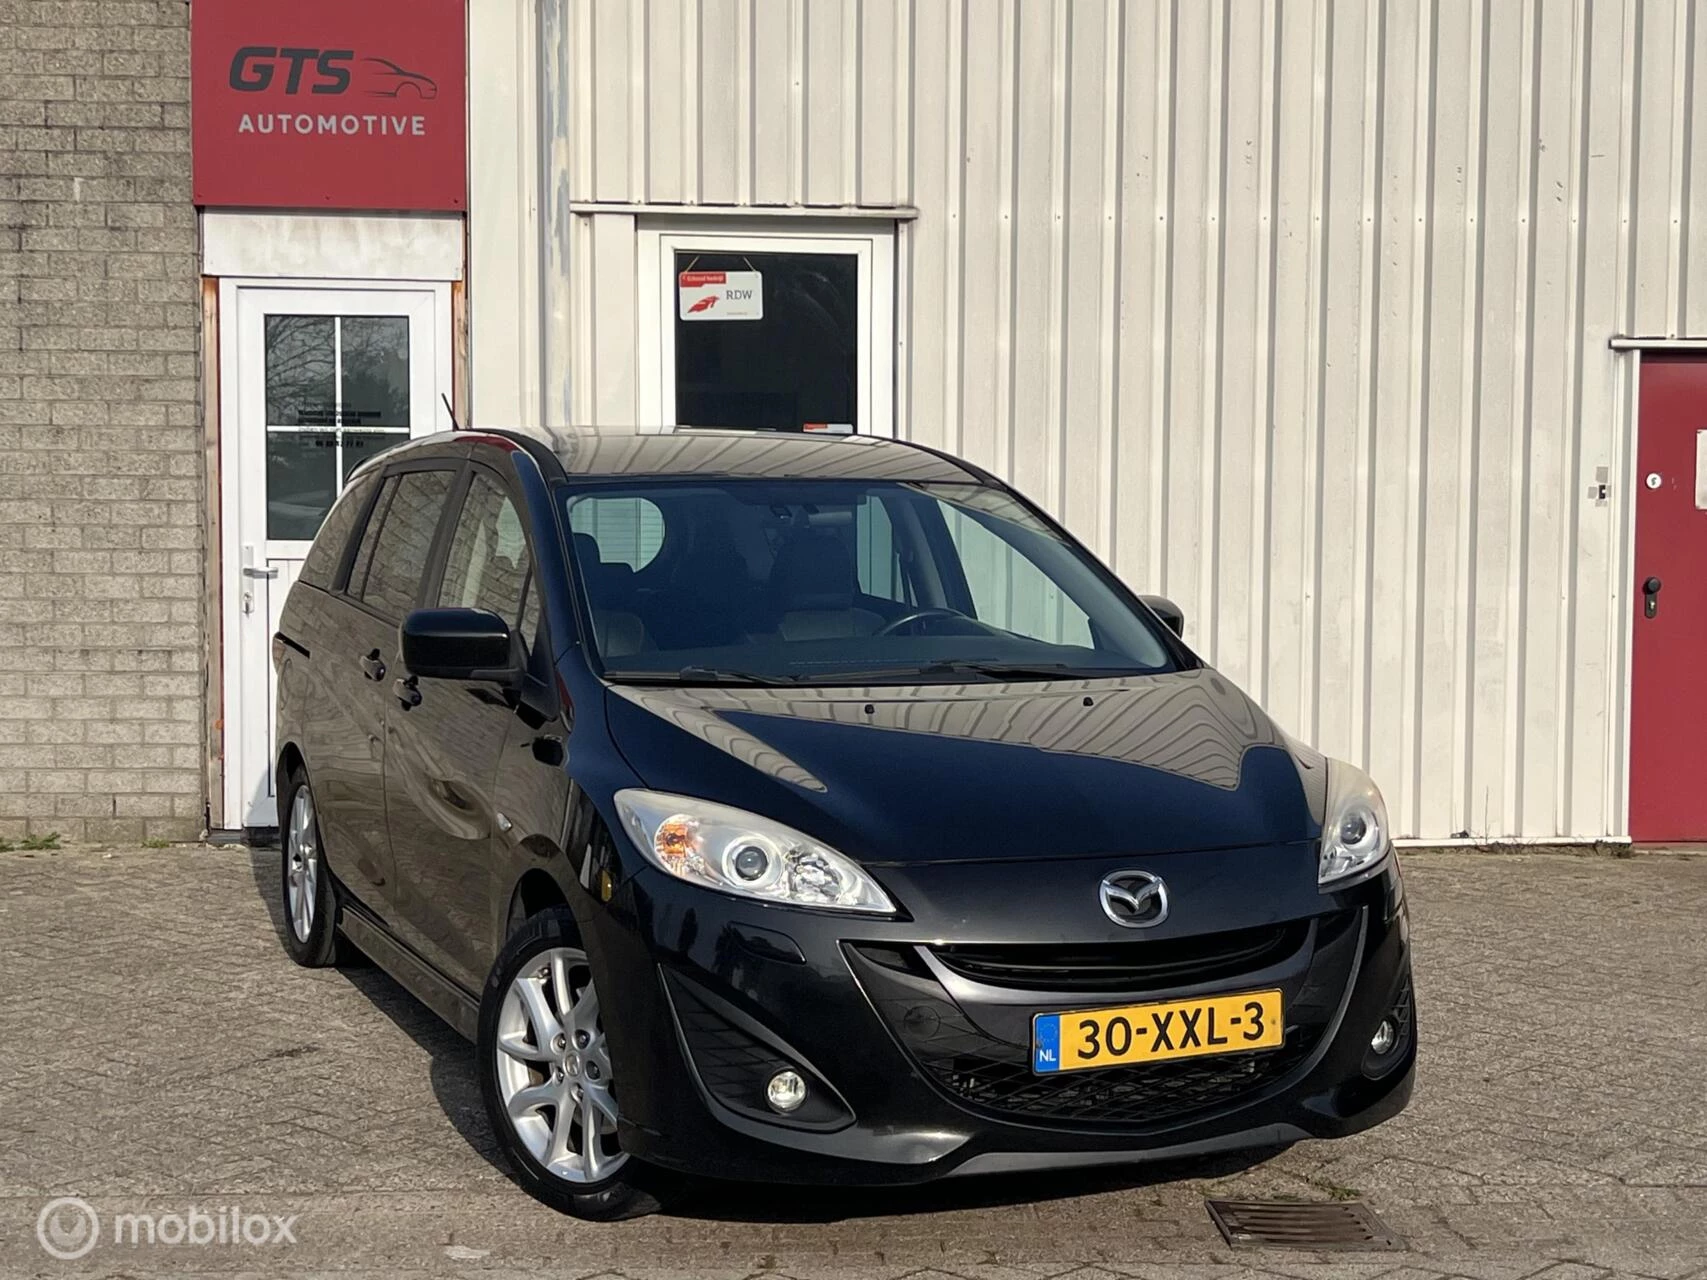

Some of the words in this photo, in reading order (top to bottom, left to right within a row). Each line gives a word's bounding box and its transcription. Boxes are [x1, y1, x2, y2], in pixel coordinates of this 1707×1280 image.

[229, 46, 354, 95] GTS
[238, 114, 425, 136] AUTOMOTIVE
[726, 290, 753, 300] RDW
[1077, 1002, 1264, 1060] 30-XXL-3
[1039, 1050, 1056, 1062] NL
